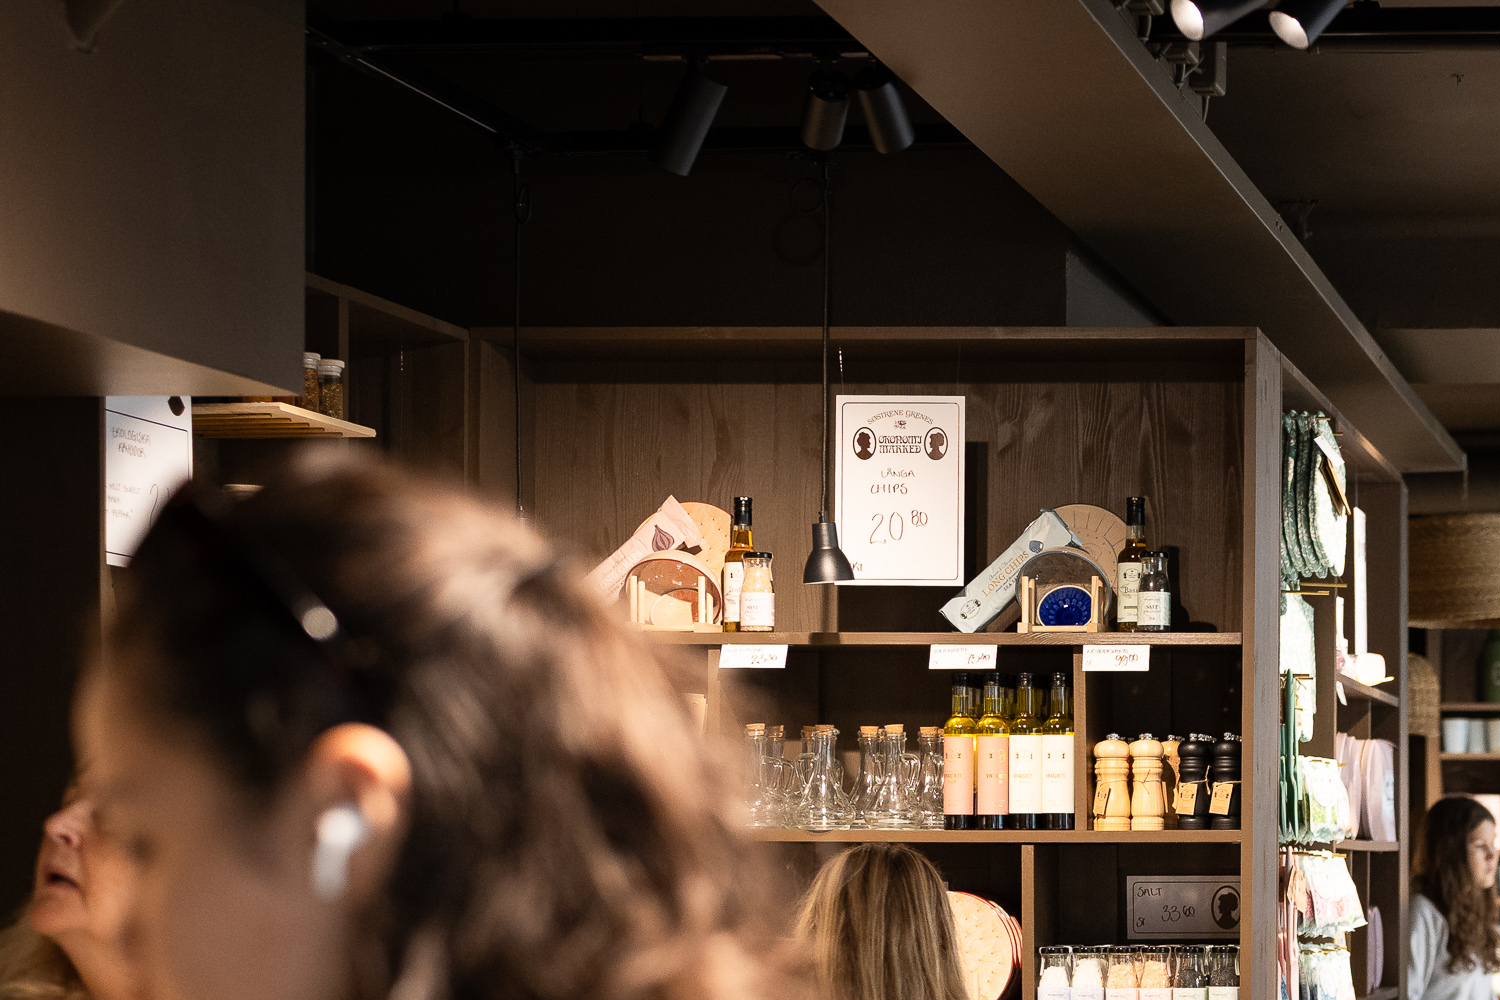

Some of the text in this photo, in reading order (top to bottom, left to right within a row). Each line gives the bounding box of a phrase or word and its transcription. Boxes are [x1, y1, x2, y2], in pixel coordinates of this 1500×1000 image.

[880, 467, 916, 478] LÅNGA
[870, 483, 908, 495] CHIPS
[981, 572, 1007, 597] LONG
[1005, 550, 1030, 575] CHIPS
[1136, 886, 1163, 898] SALT
